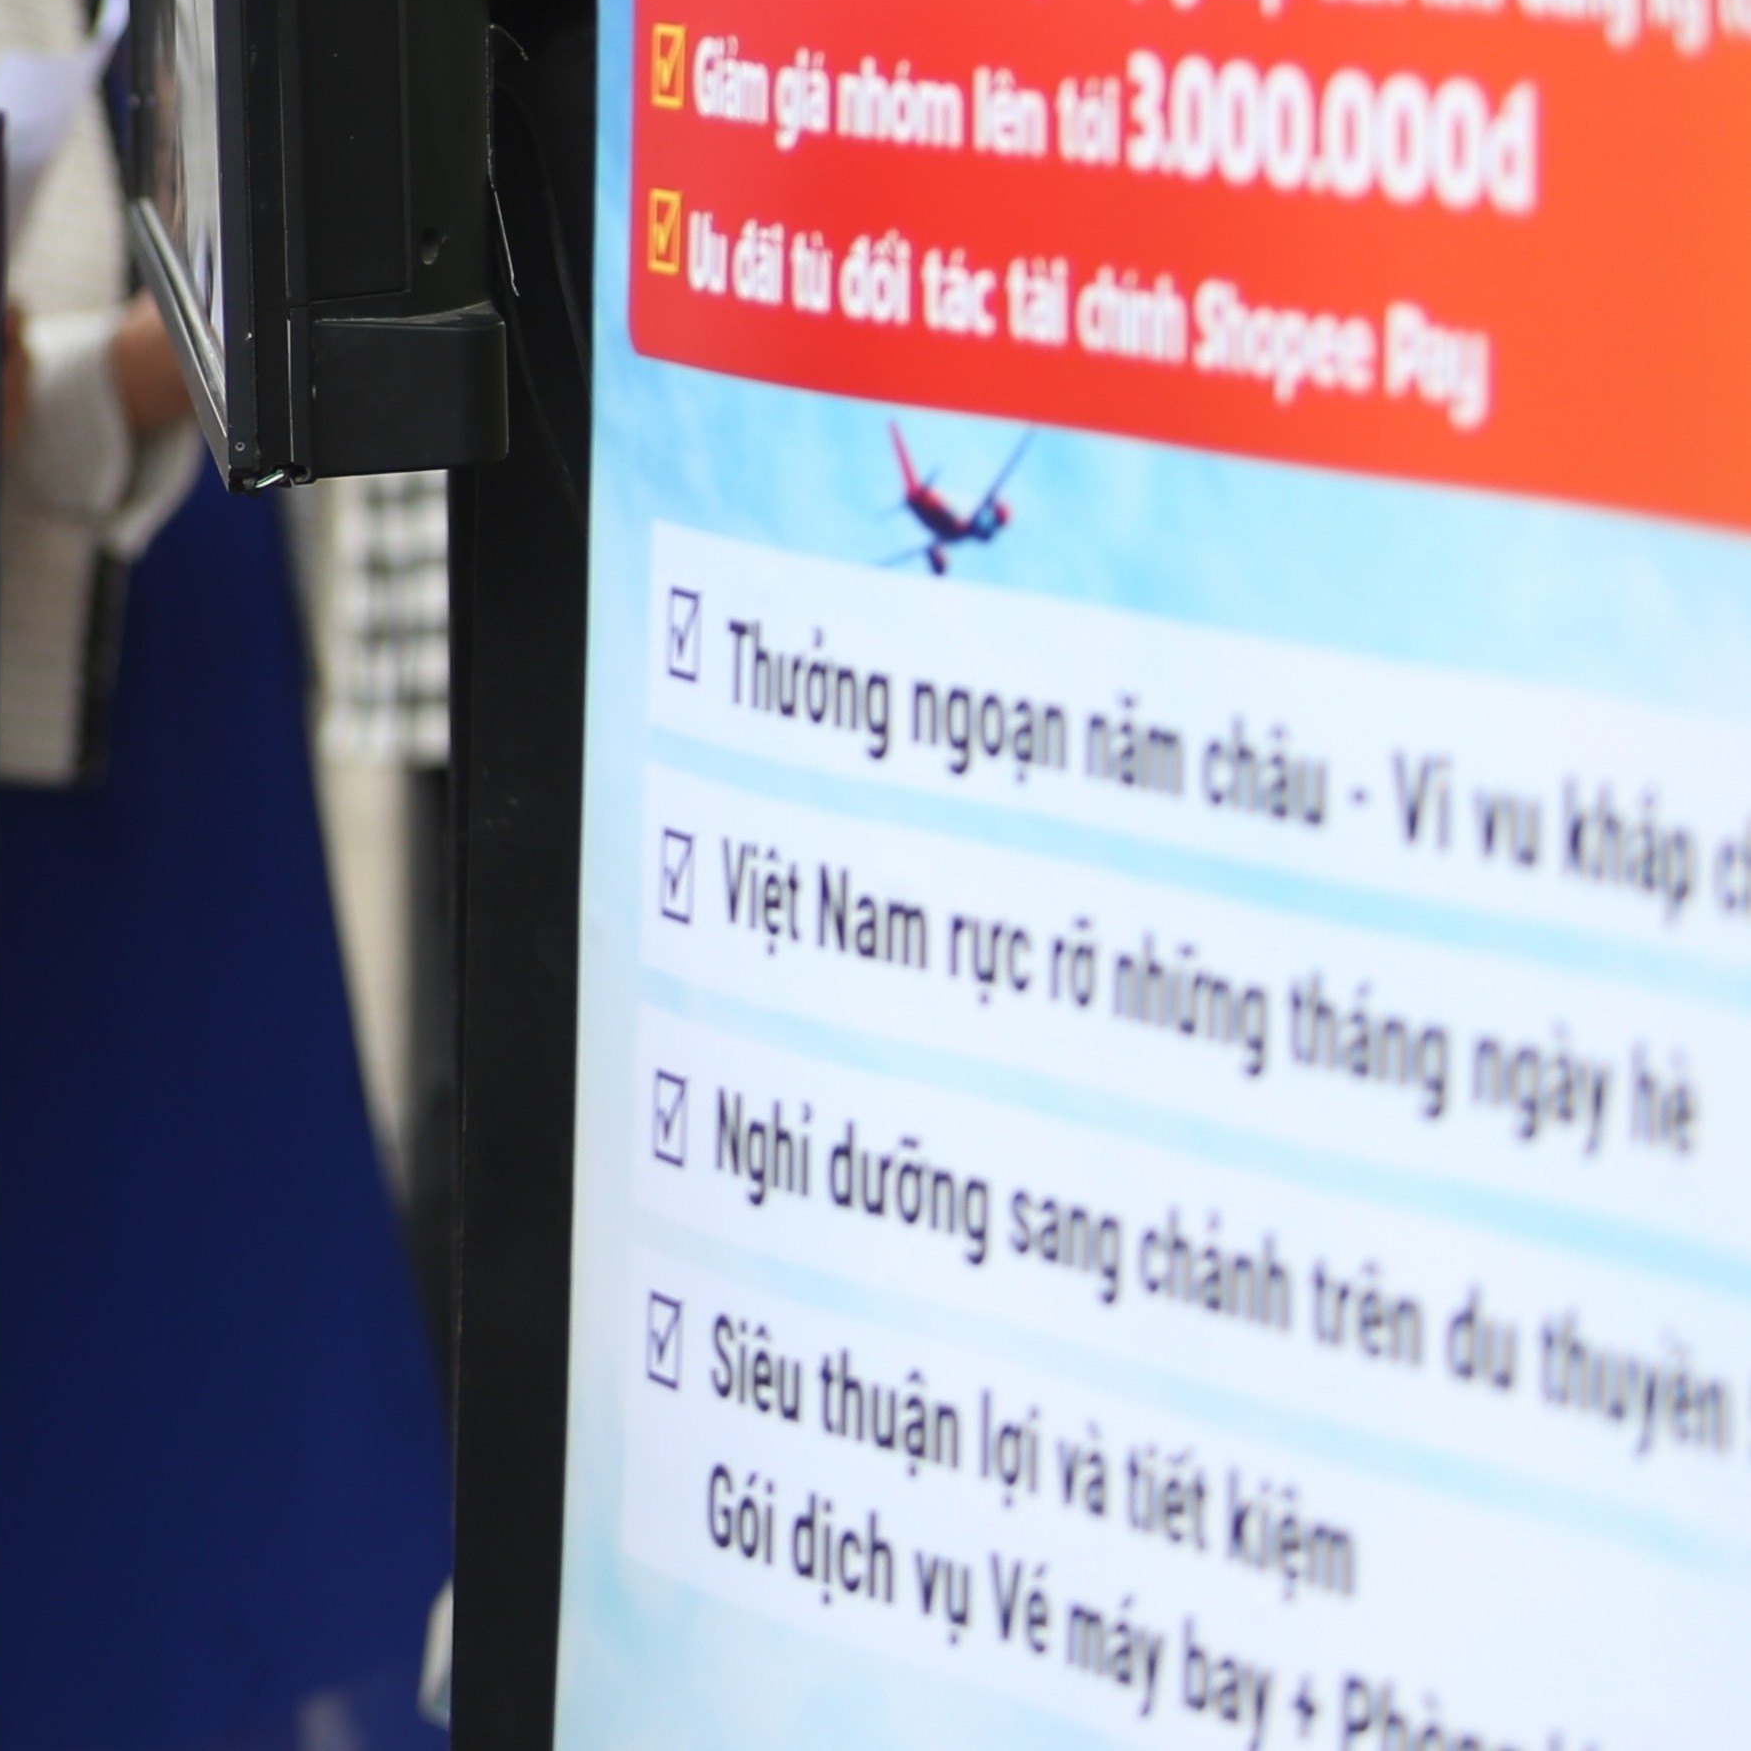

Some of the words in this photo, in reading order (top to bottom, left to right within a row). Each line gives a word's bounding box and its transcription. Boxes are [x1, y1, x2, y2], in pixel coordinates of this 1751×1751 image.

[774, 46, 831, 151] giá
[836, 53, 965, 149] nhóm
[972, 64, 1049, 158] lên
[921, 245, 998, 339] tác
[1006, 254, 1070, 348] tài
[1075, 263, 1189, 367] chính
[1192, 276, 1377, 405] Shopee
[1382, 297, 1491, 432] Pay
[727, 618, 891, 760] Thưởng
[912, 680, 1068, 784] ngoạn
[721, 835, 801, 956] Việt
[817, 861, 928, 970] Nam
[949, 911, 1032, 1005] rực
[1112, 930, 1268, 1078] những
[1289, 970, 1449, 1119] tháng
[715, 1085, 814, 1207] Nghỉ
[829, 1118, 989, 1266] dưỡng
[1010, 1189, 1122, 1305] sang
[1309, 1257, 1424, 1369] trên
[1445, 1281, 1518, 1391] du
[710, 1313, 801, 1423] Siêu
[820, 1347, 959, 1478] thuận
[981, 1388, 1040, 1508] lợi
[1056, 1420, 1107, 1517] và
[1126, 1444, 1207, 1551] tiết
[1227, 1465, 1356, 1601] kiệm
[707, 1462, 774, 1566] Gói
[792, 1492, 895, 1606] dịch
[914, 1550, 973, 1646] vụ
[990, 1550, 1050, 1654] Vé
[1067, 1593, 1166, 1718] máy
[1184, 1615, 1273, 1751] bay
